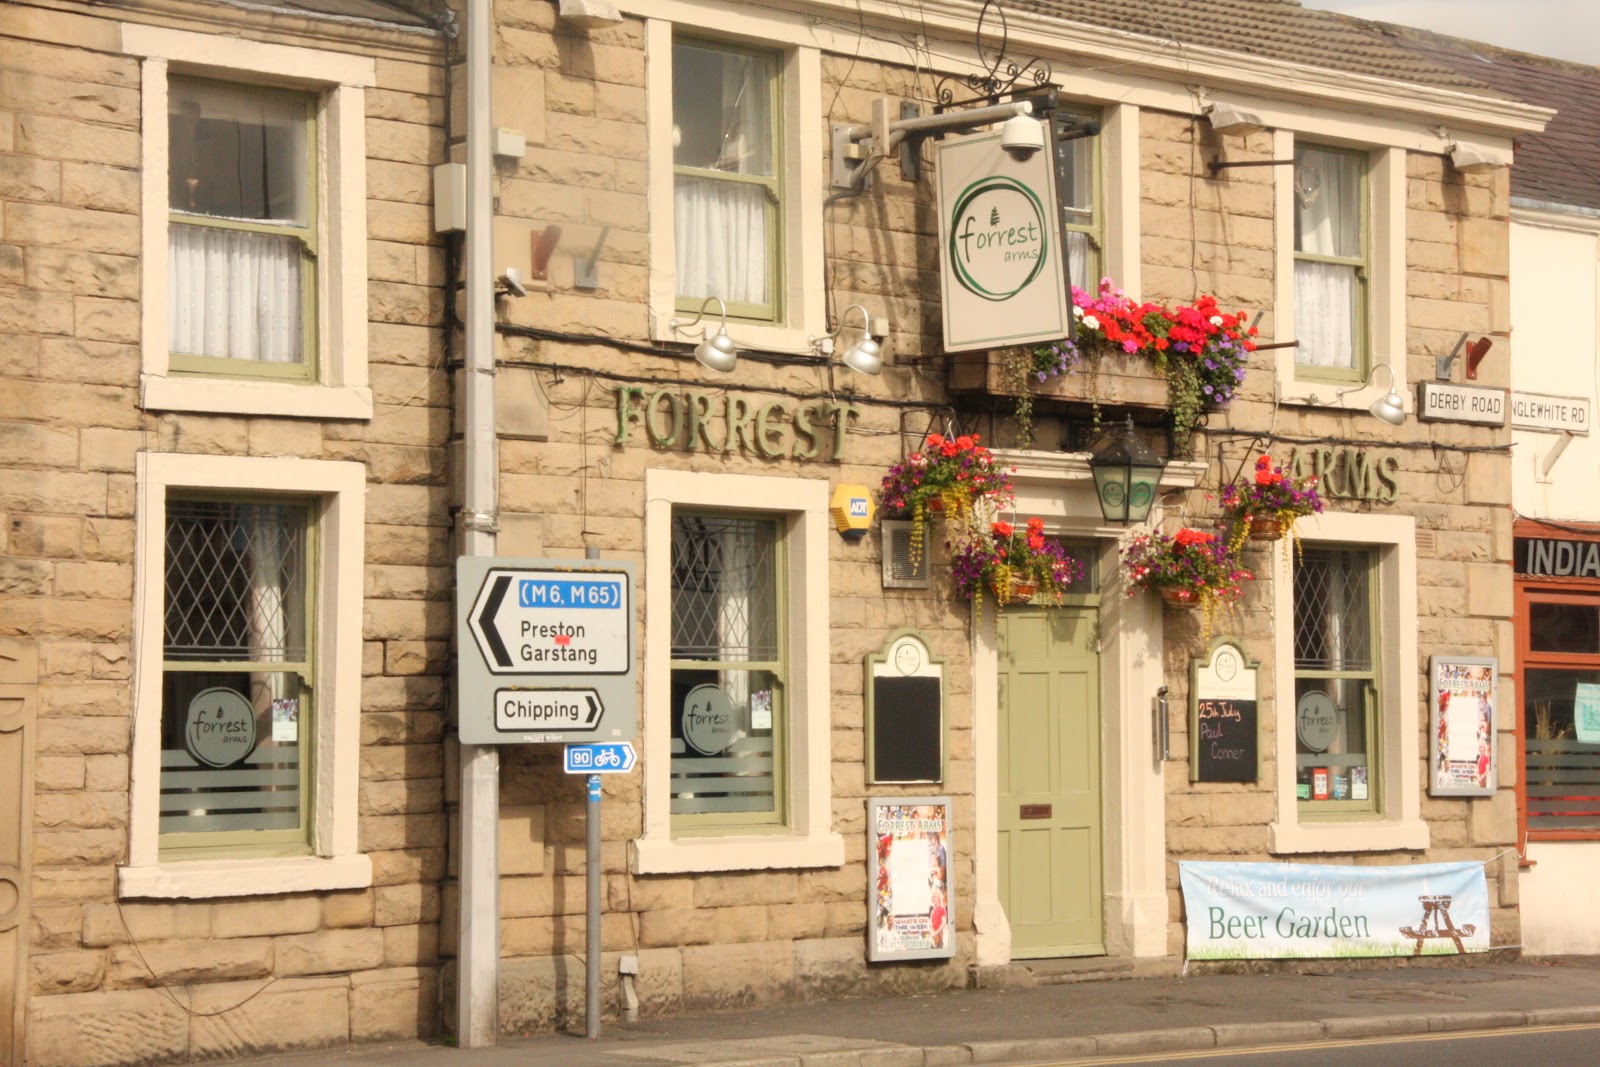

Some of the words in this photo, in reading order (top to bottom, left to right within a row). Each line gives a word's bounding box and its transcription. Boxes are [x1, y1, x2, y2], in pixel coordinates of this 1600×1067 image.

[958, 215, 1038, 263] forrest
[1004, 248, 1039, 262] arms
[1430, 392, 1467, 411] DERBY
[1471, 396, 1500, 414] ROAD
[615, 386, 861, 460] FORREST
[1571, 407, 1585, 423] RD
[1288, 446, 1401, 502] ARMS
[850, 501, 868, 514] ADT
[1526, 539, 1600, 578] INDIA
[520, 620, 585, 638] Preston
[520, 644, 597, 664] Garstang
[503, 700, 579, 720] Chipping
[193, 710, 248, 741] forrest
[223, 735, 248, 743] arms
[573, 752, 590, 764] 90
[878, 820, 914, 831] FORREST
[917, 820, 942, 830] ARMS
[1207, 875, 1255, 897] Relax
[1258, 877, 1288, 897] and
[1291, 878, 1336, 902] enjoy
[1338, 881, 1368, 897] our
[1208, 906, 1268, 940] Beer
[1275, 907, 1370, 939] Garden
